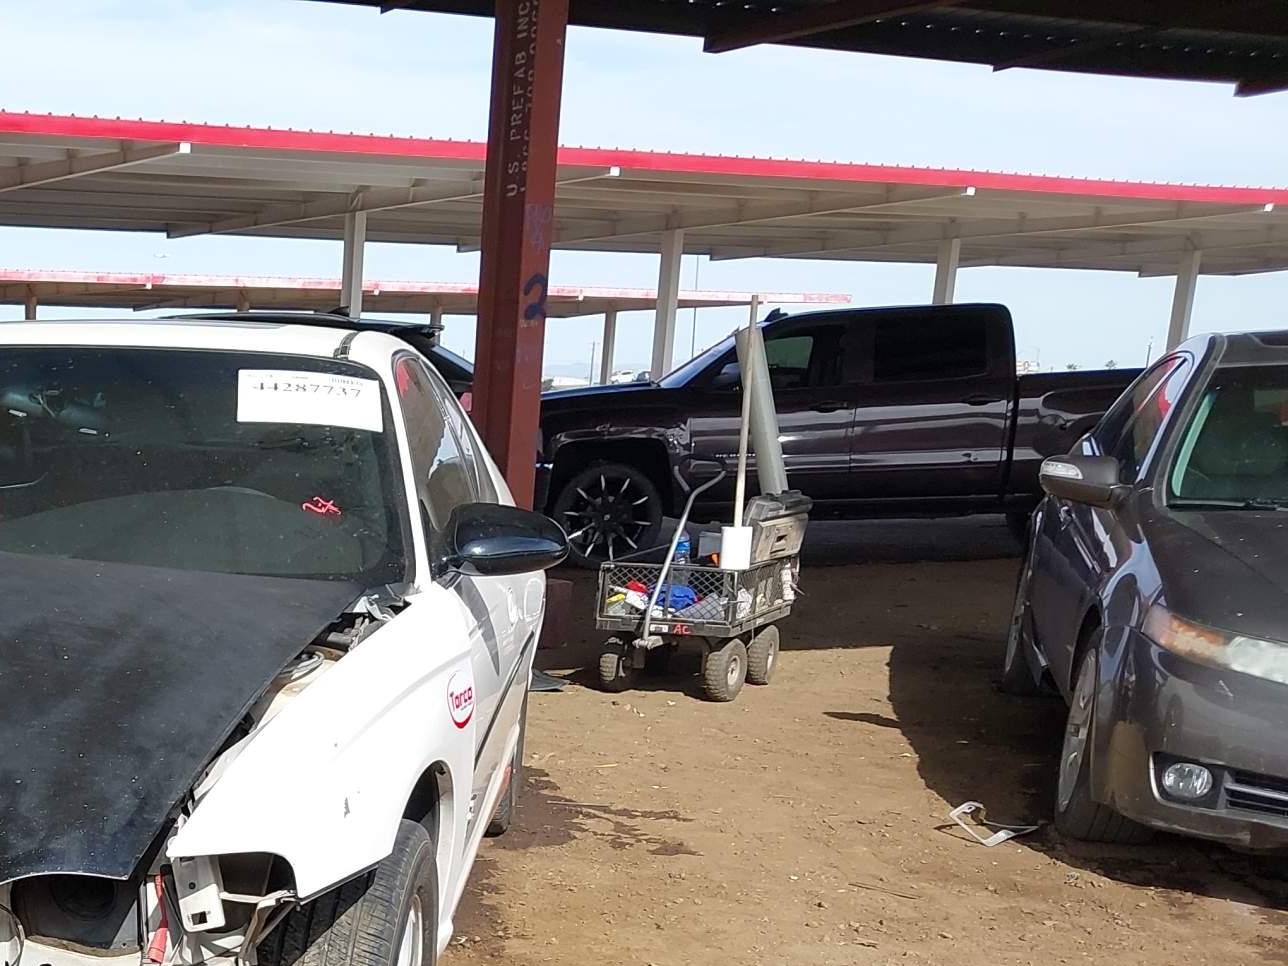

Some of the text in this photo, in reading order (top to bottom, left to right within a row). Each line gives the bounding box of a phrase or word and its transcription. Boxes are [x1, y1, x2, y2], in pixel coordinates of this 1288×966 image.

[510, 51, 527, 140] PREFAB
[523, 273, 548, 321] 2
[252, 382, 361, 397] 44287737
